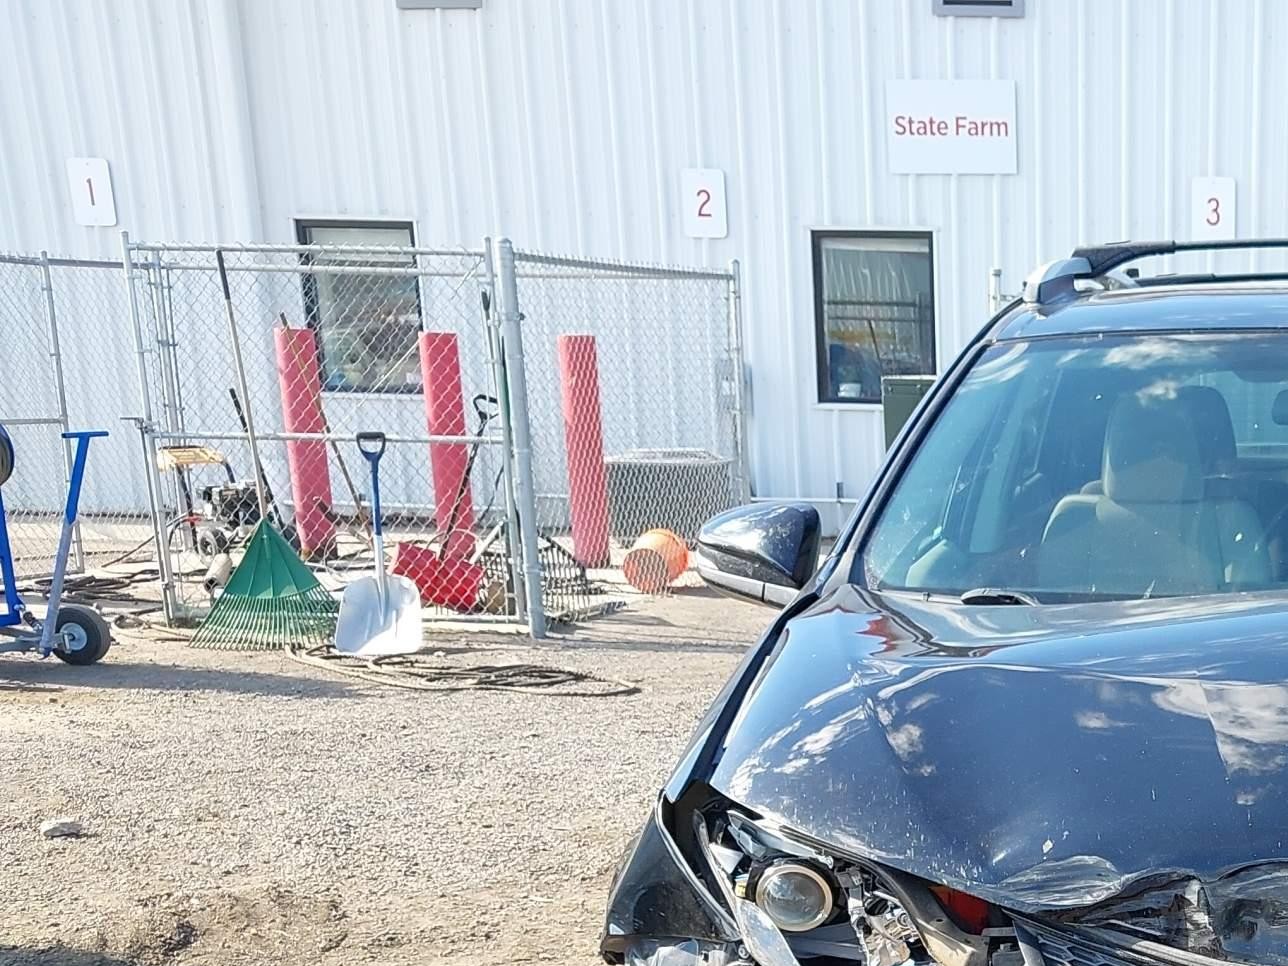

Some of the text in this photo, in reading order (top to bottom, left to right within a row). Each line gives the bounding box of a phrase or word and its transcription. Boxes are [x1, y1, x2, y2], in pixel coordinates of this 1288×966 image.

[895, 115, 1009, 137] State Farm
[86, 177, 95, 206] 1
[696, 189, 712, 217] 2
[1206, 197, 1220, 226] 3
